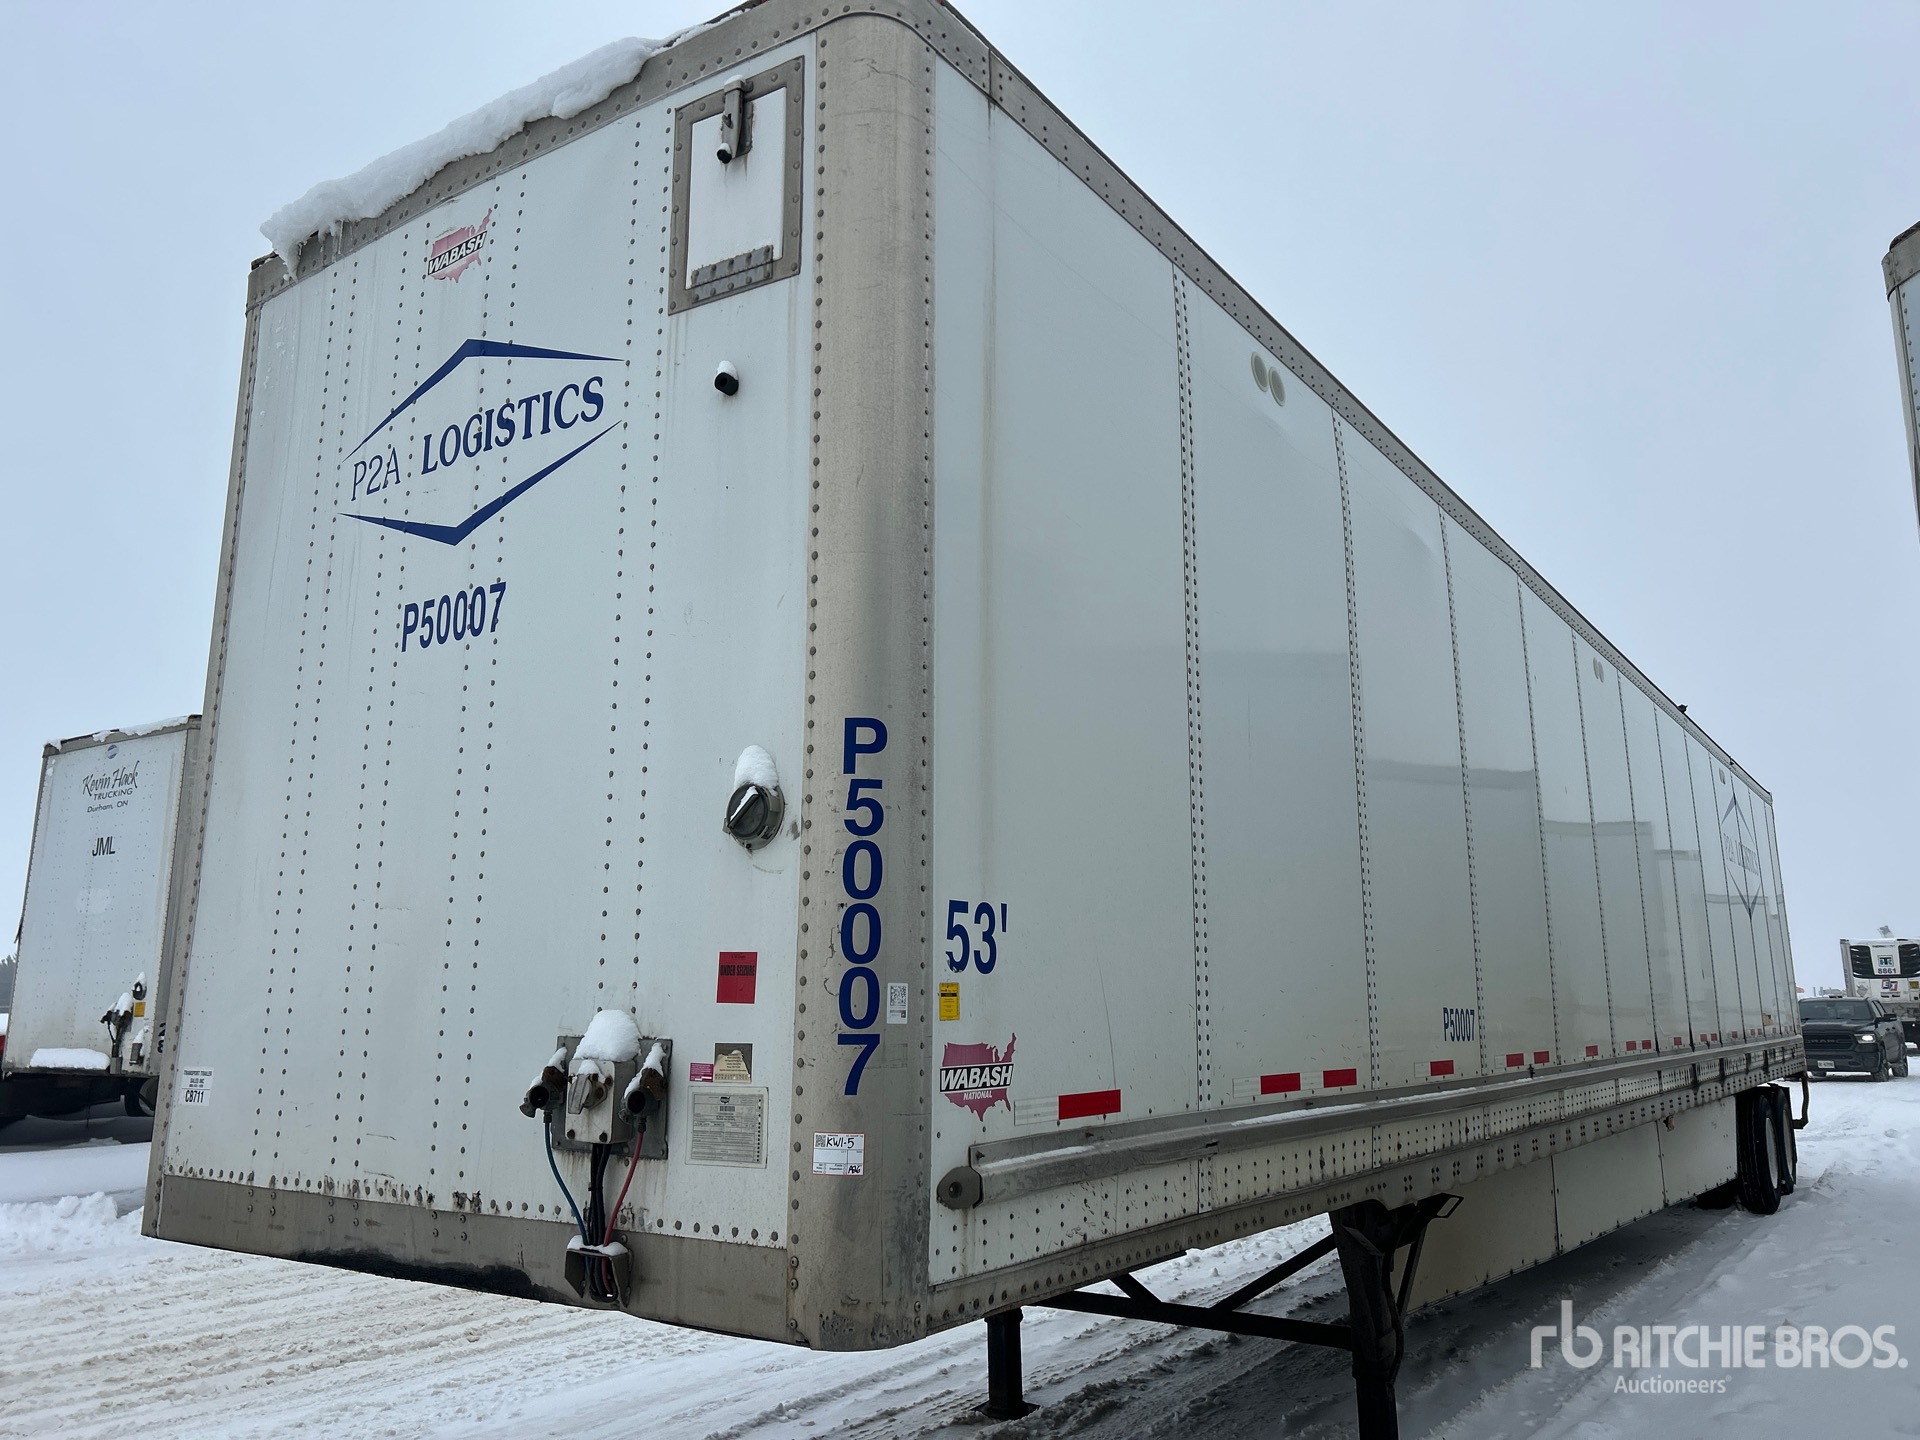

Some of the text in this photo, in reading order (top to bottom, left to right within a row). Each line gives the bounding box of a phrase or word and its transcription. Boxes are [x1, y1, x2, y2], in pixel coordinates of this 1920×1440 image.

[428, 232, 487, 274] WABASH
[351, 376, 604, 502] P2A LOGISTICS
[401, 581, 506, 653] P50007
[82, 760, 139, 797] Kevin Hack
[94, 788, 133, 801] TRUCKING
[116, 800, 128, 808] ON
[92, 836, 116, 856] JML
[836, 717, 888, 1096] P50007
[945, 900, 1008, 975] 53'
[1443, 1007, 1475, 1041] P50007
[941, 1065, 1013, 1091] WABASH
[963, 1090, 993, 1100] NATIONAL
